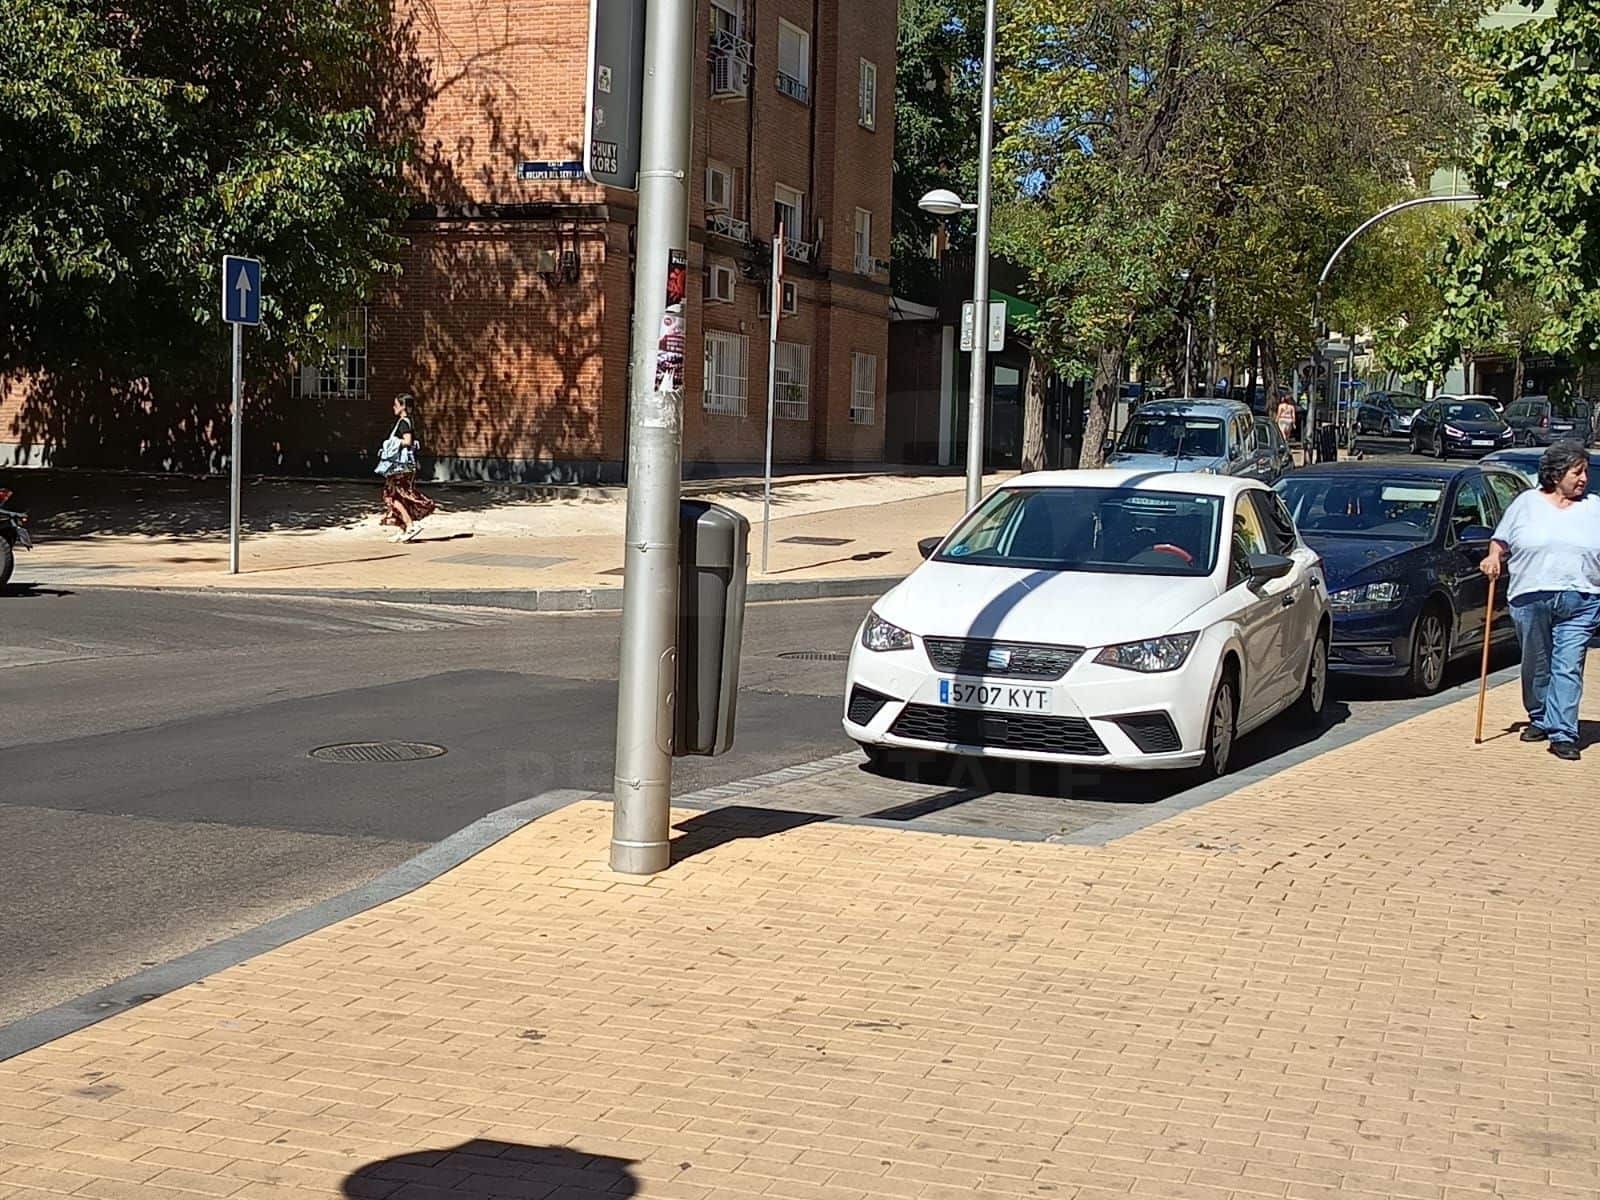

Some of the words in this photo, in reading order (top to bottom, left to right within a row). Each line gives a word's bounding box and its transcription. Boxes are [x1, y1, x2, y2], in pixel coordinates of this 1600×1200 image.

[591, 141, 617, 157] CHUKY
[591, 158, 617, 173] KORS
[953, 684, 1001, 705] 5707
[1008, 688, 1047, 709] KYT
